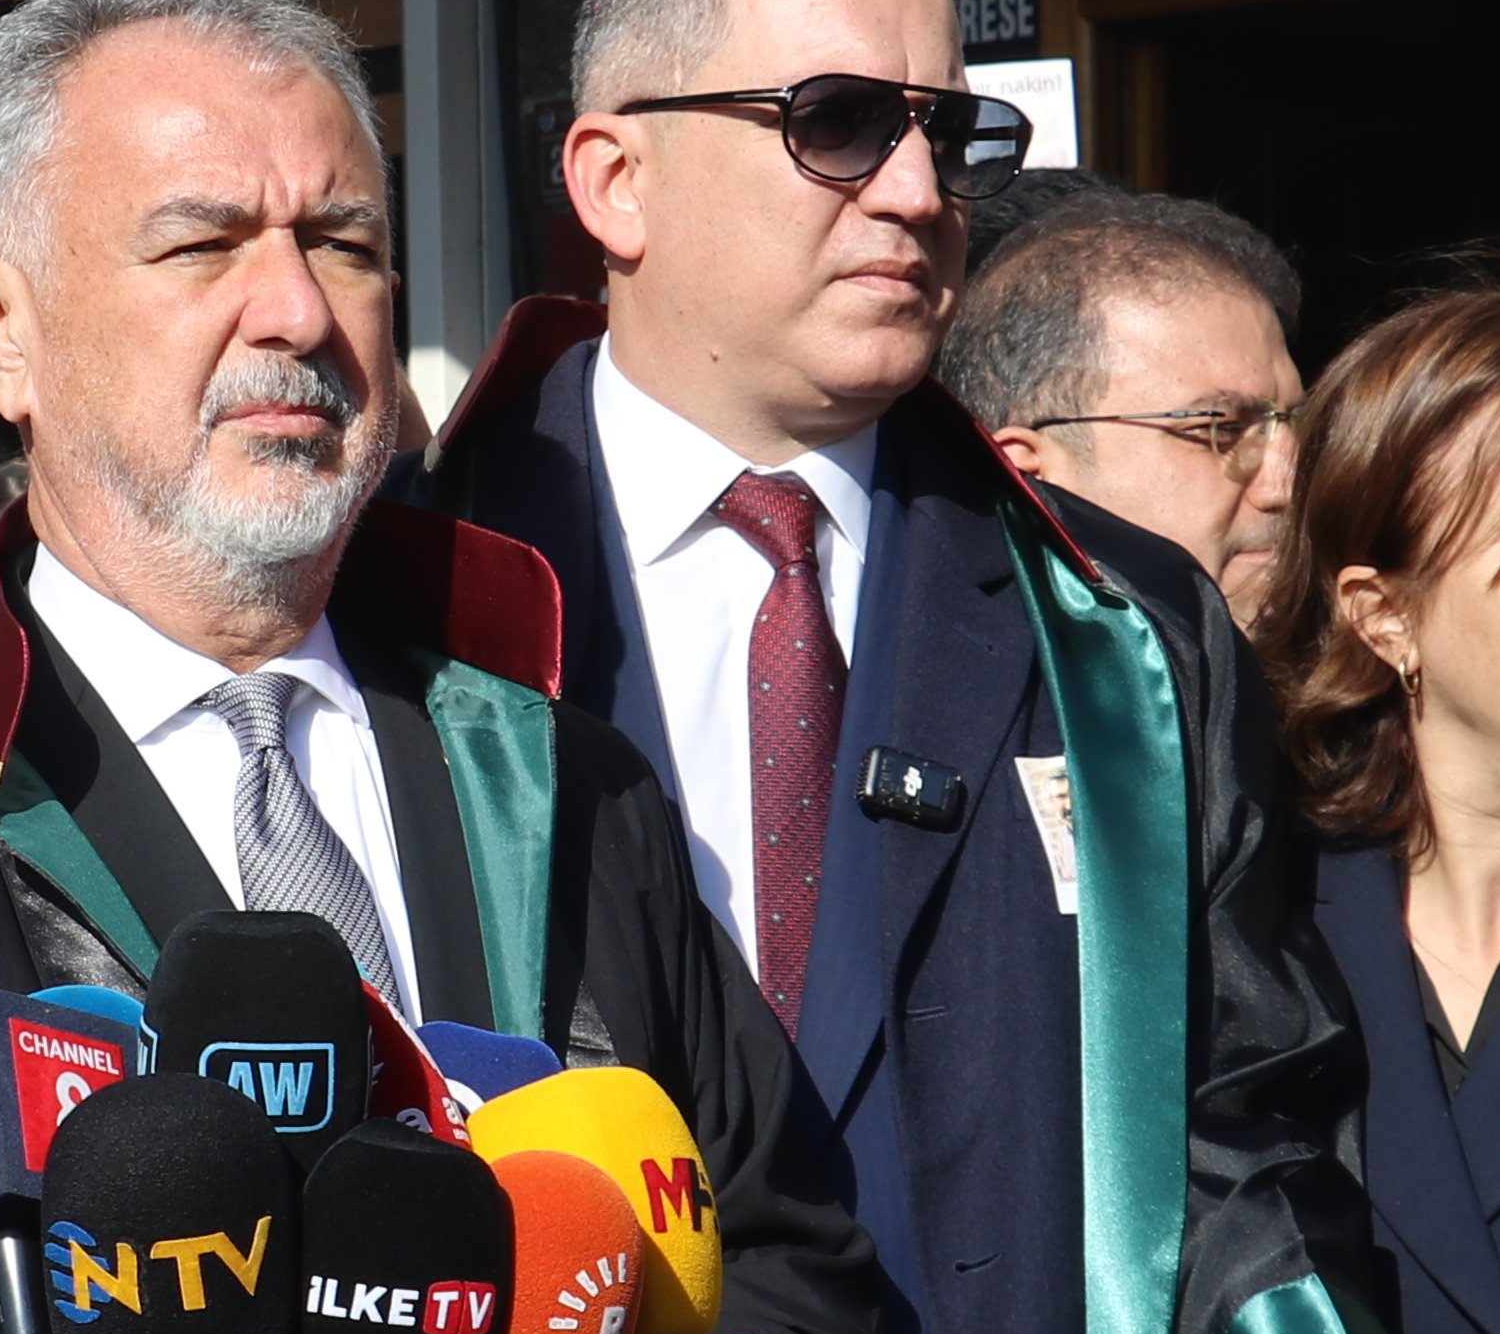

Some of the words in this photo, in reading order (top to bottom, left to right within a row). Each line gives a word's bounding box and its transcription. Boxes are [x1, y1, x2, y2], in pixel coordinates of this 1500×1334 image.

[18, 1031, 120, 1076] CHANNEL
[67, 1216, 272, 1316] NTV
[432, 1291, 493, 1330] TV
